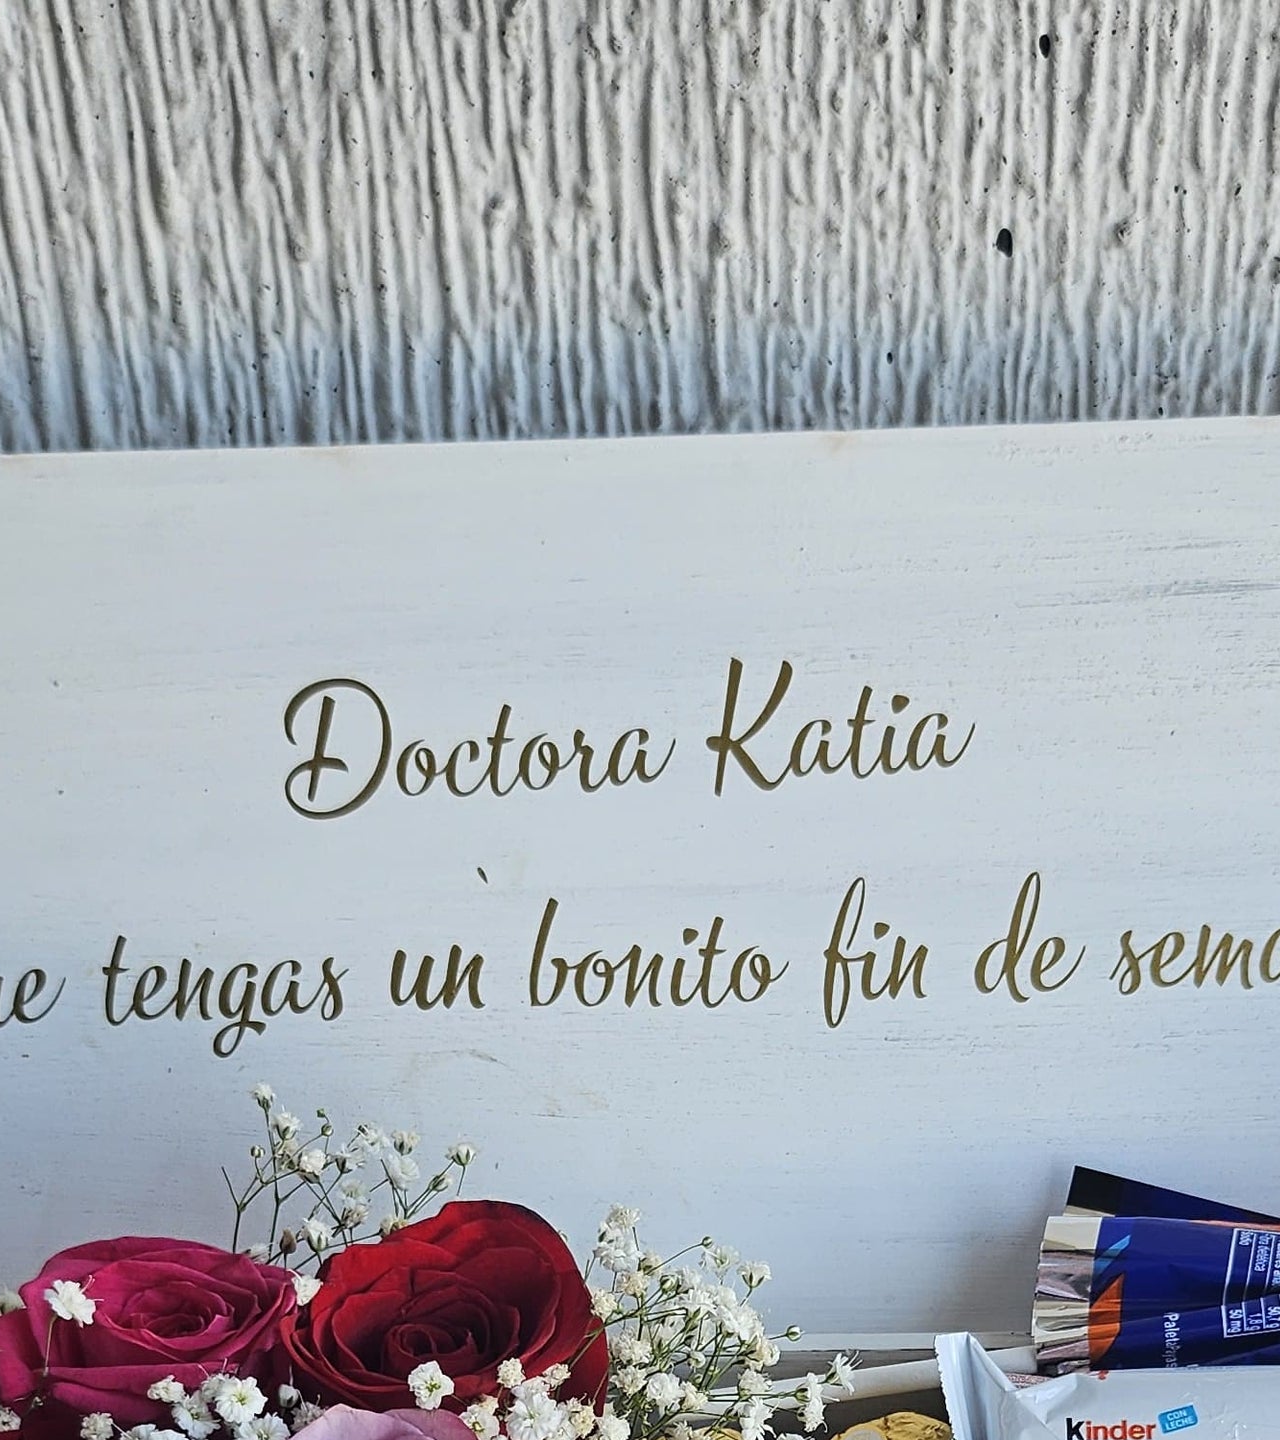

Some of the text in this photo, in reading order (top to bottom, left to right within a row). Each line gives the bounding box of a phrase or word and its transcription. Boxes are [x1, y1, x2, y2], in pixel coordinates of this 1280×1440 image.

[284, 657, 976, 820] Doctora Katia
[103, 935, 350, 1058] tengas
[390, 943, 485, 1009] un
[530, 896, 781, 1009] bonito
[824, 879, 929, 1028] fin
[975, 872, 1084, 1002] de
[1227, 1309, 1242, 1333] 50 mg
[1247, 1313, 1263, 1325] 1,8
[1165, 1416, 1195, 1431] LECHE
[1166, 1410, 1188, 1422] CON
